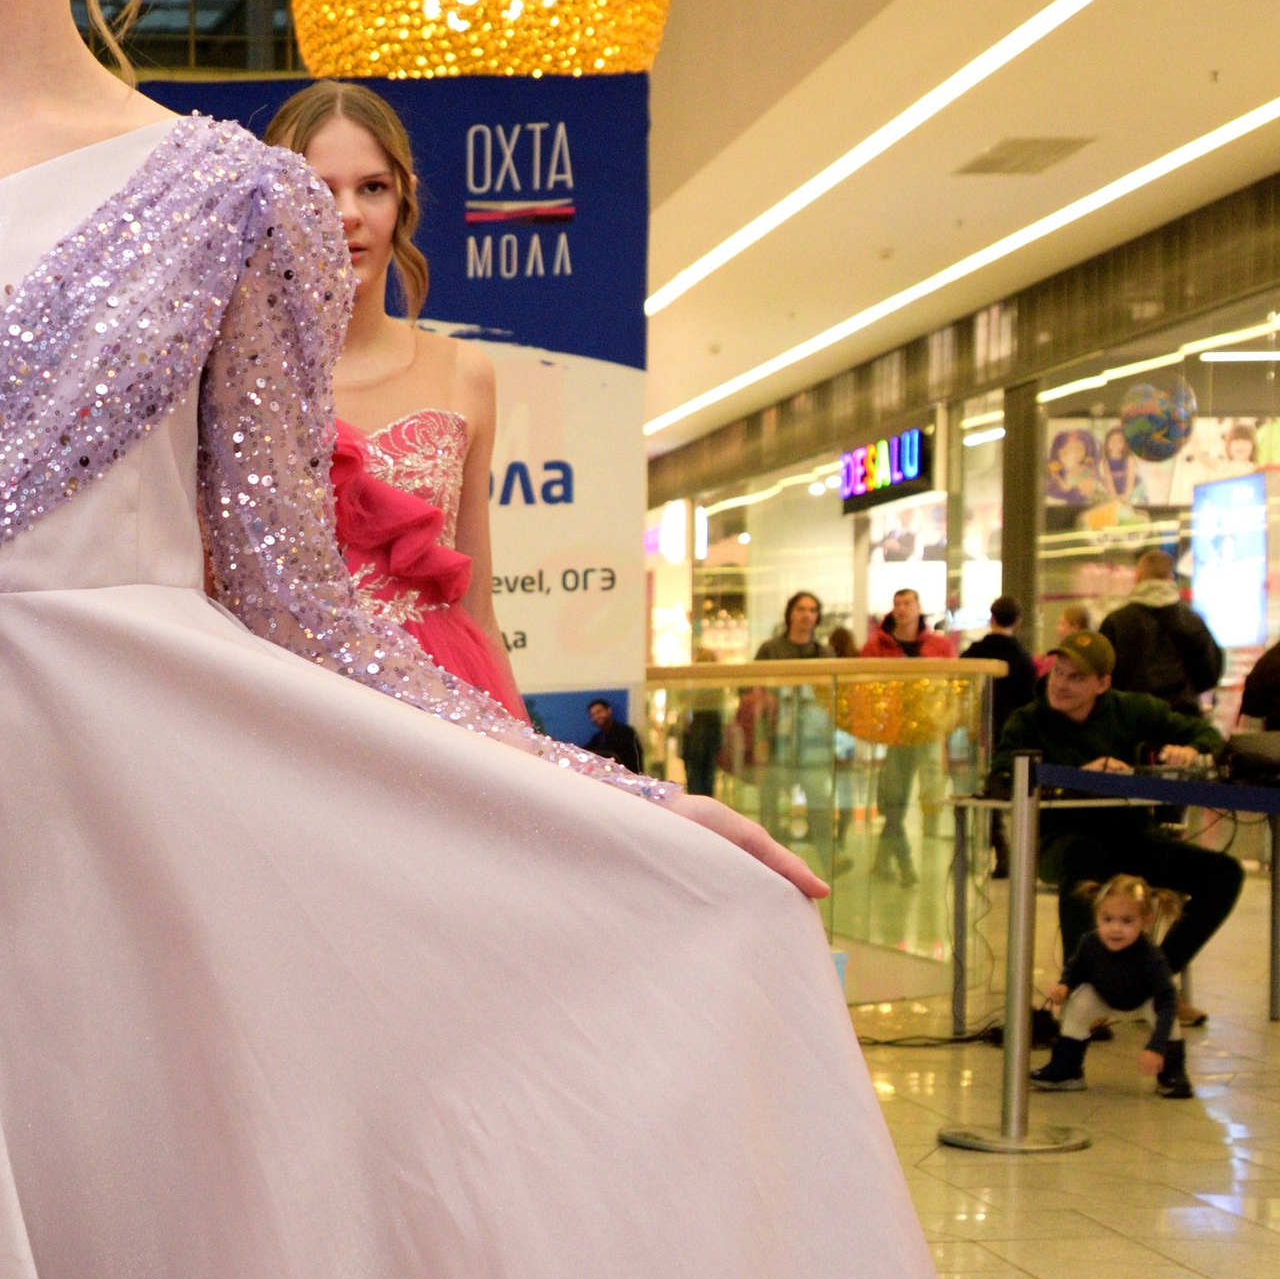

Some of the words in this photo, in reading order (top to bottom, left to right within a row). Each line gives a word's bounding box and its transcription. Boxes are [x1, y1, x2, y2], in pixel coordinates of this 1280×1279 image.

[466, 122, 574, 193] ОХТА
[467, 233, 572, 279] МОЛЛ
[489, 460, 574, 506] ла
[561, 568, 617, 591] ОГЭ
